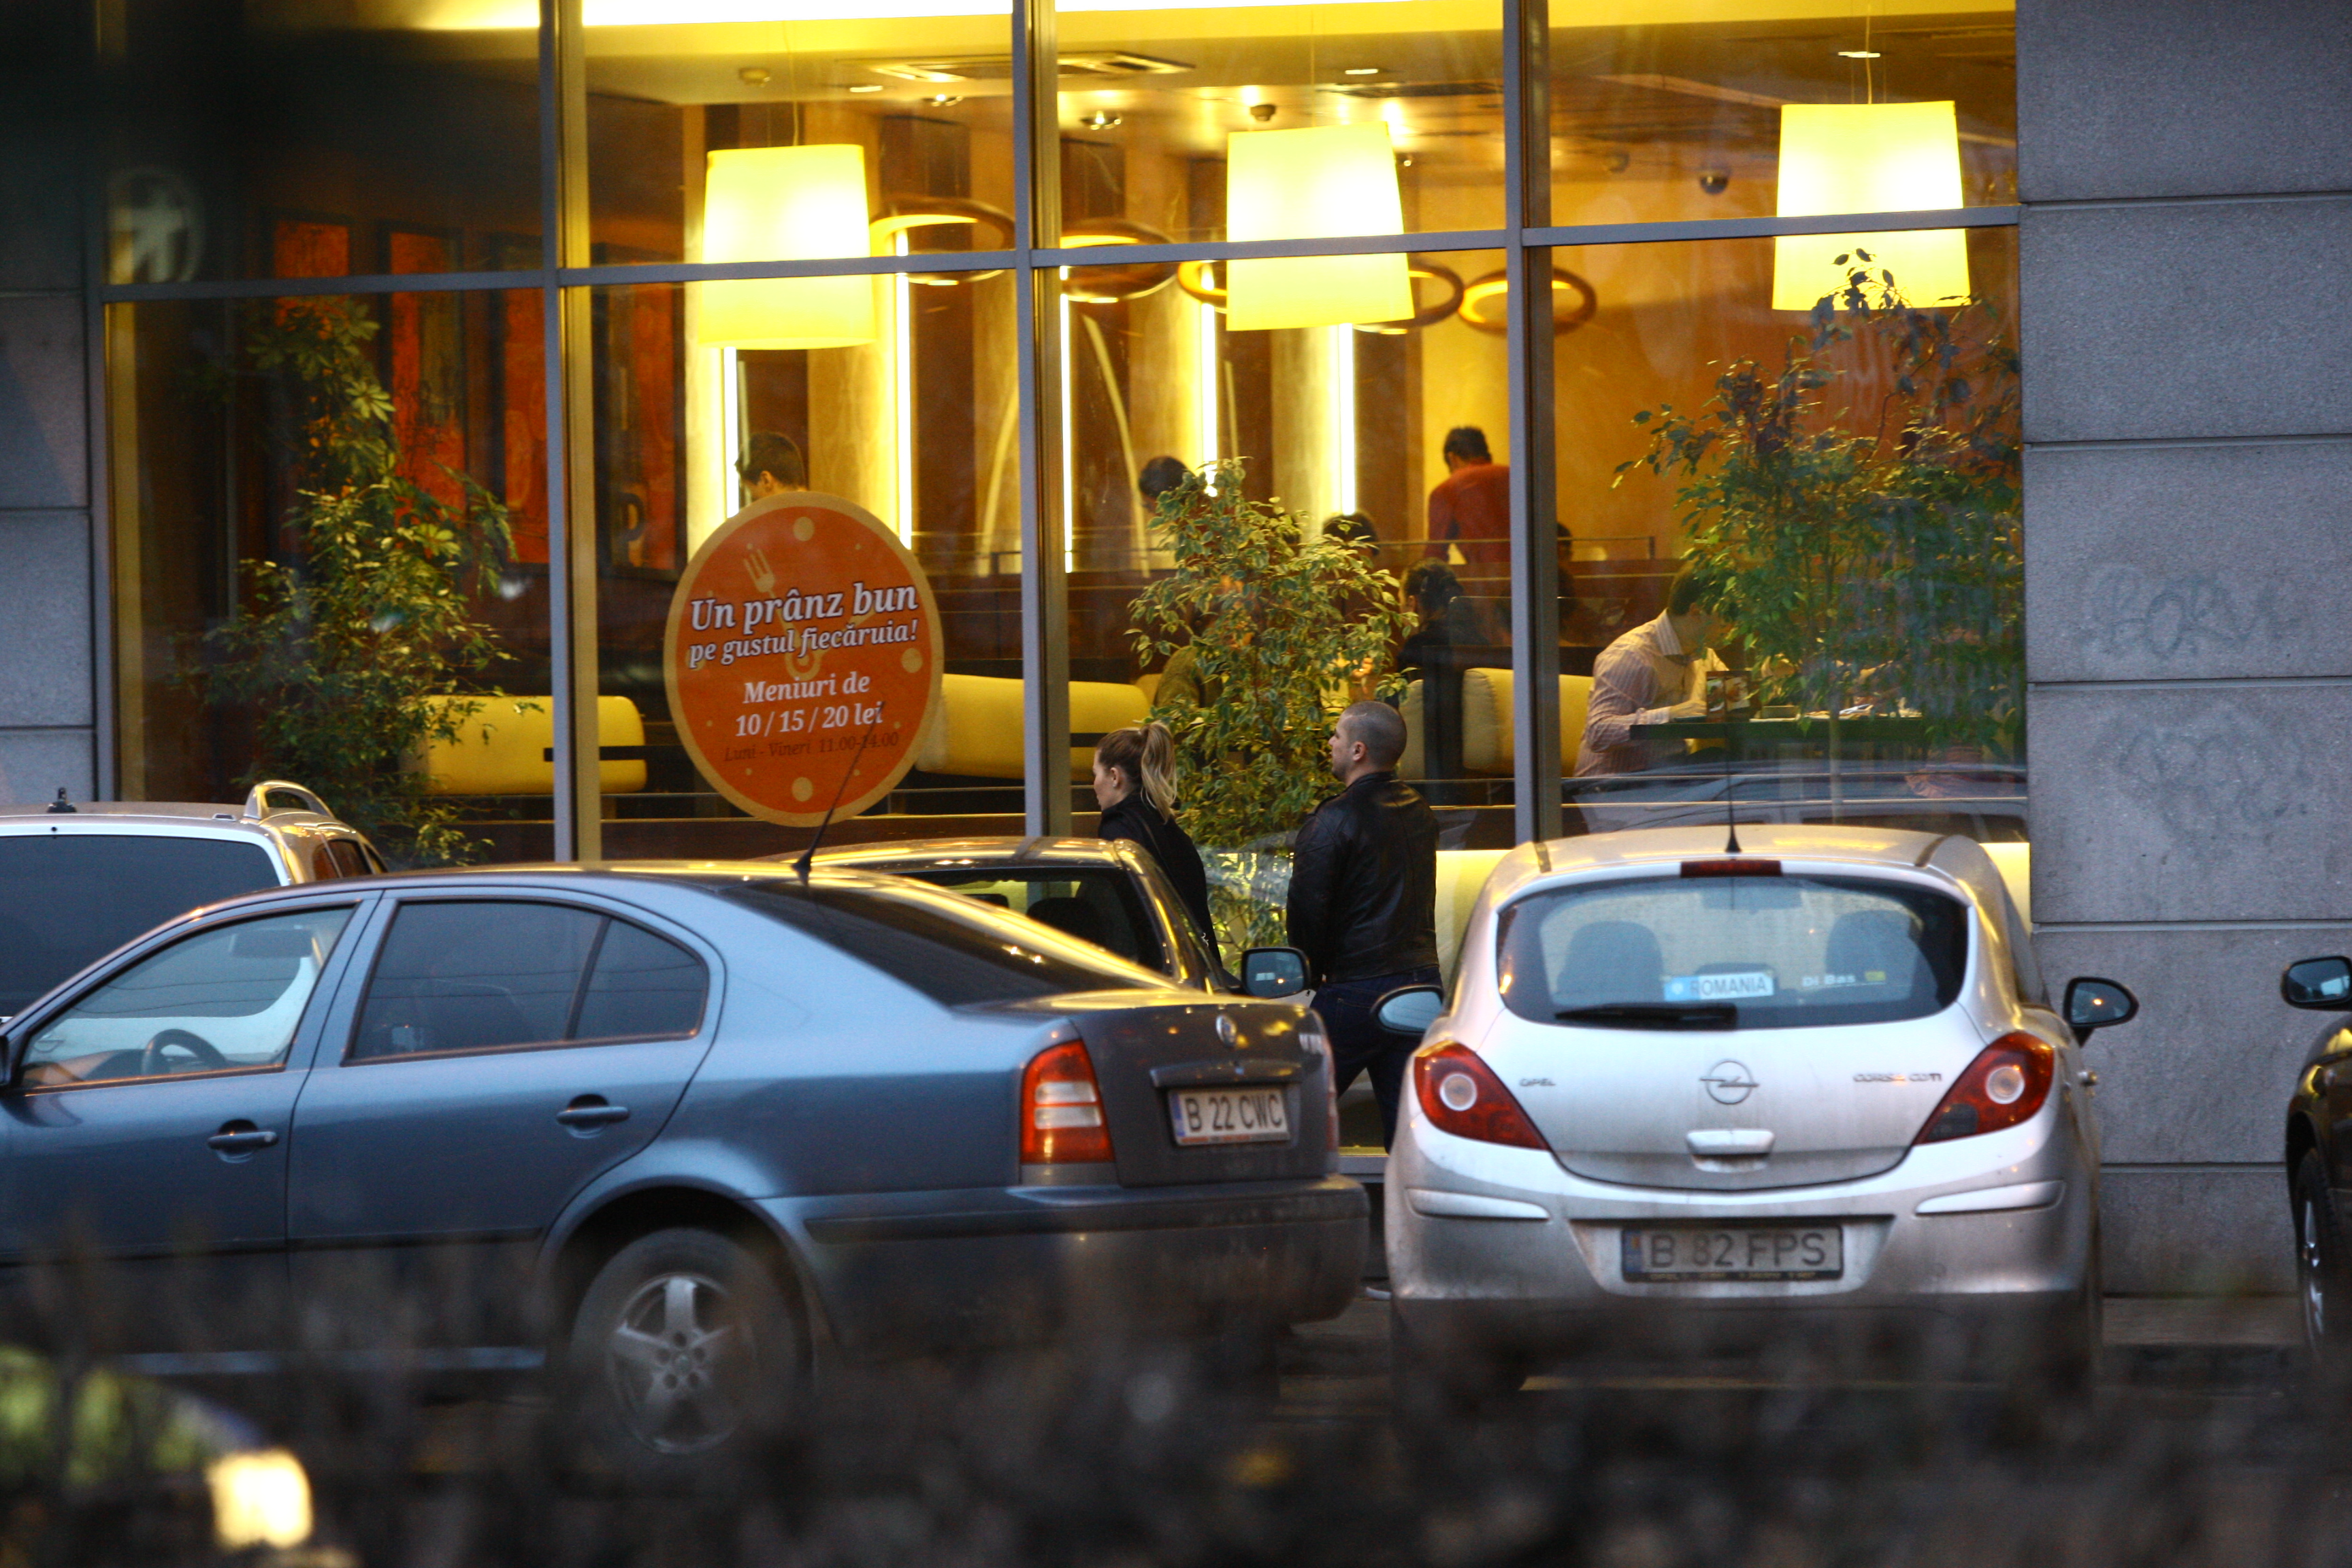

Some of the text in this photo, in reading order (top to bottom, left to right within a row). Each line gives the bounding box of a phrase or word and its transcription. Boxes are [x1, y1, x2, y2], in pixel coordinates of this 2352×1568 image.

[690, 581, 919, 635] Un prânz bun
[689, 619, 918, 668] pe gustul fiecăruia!
[742, 671, 871, 704] Meniuri de
[735, 713, 762, 736] 10
[779, 709, 805, 733] 15
[821, 705, 849, 729] 20
[853, 700, 883, 726] lei
[724, 744, 757, 762] Luni
[768, 740, 811, 757] Vineri
[1689, 976, 1768, 996] ROMANIA
[1185, 1094, 1283, 1132] B 22 CWC
[1650, 1232, 1827, 1269] B 82 FPS
